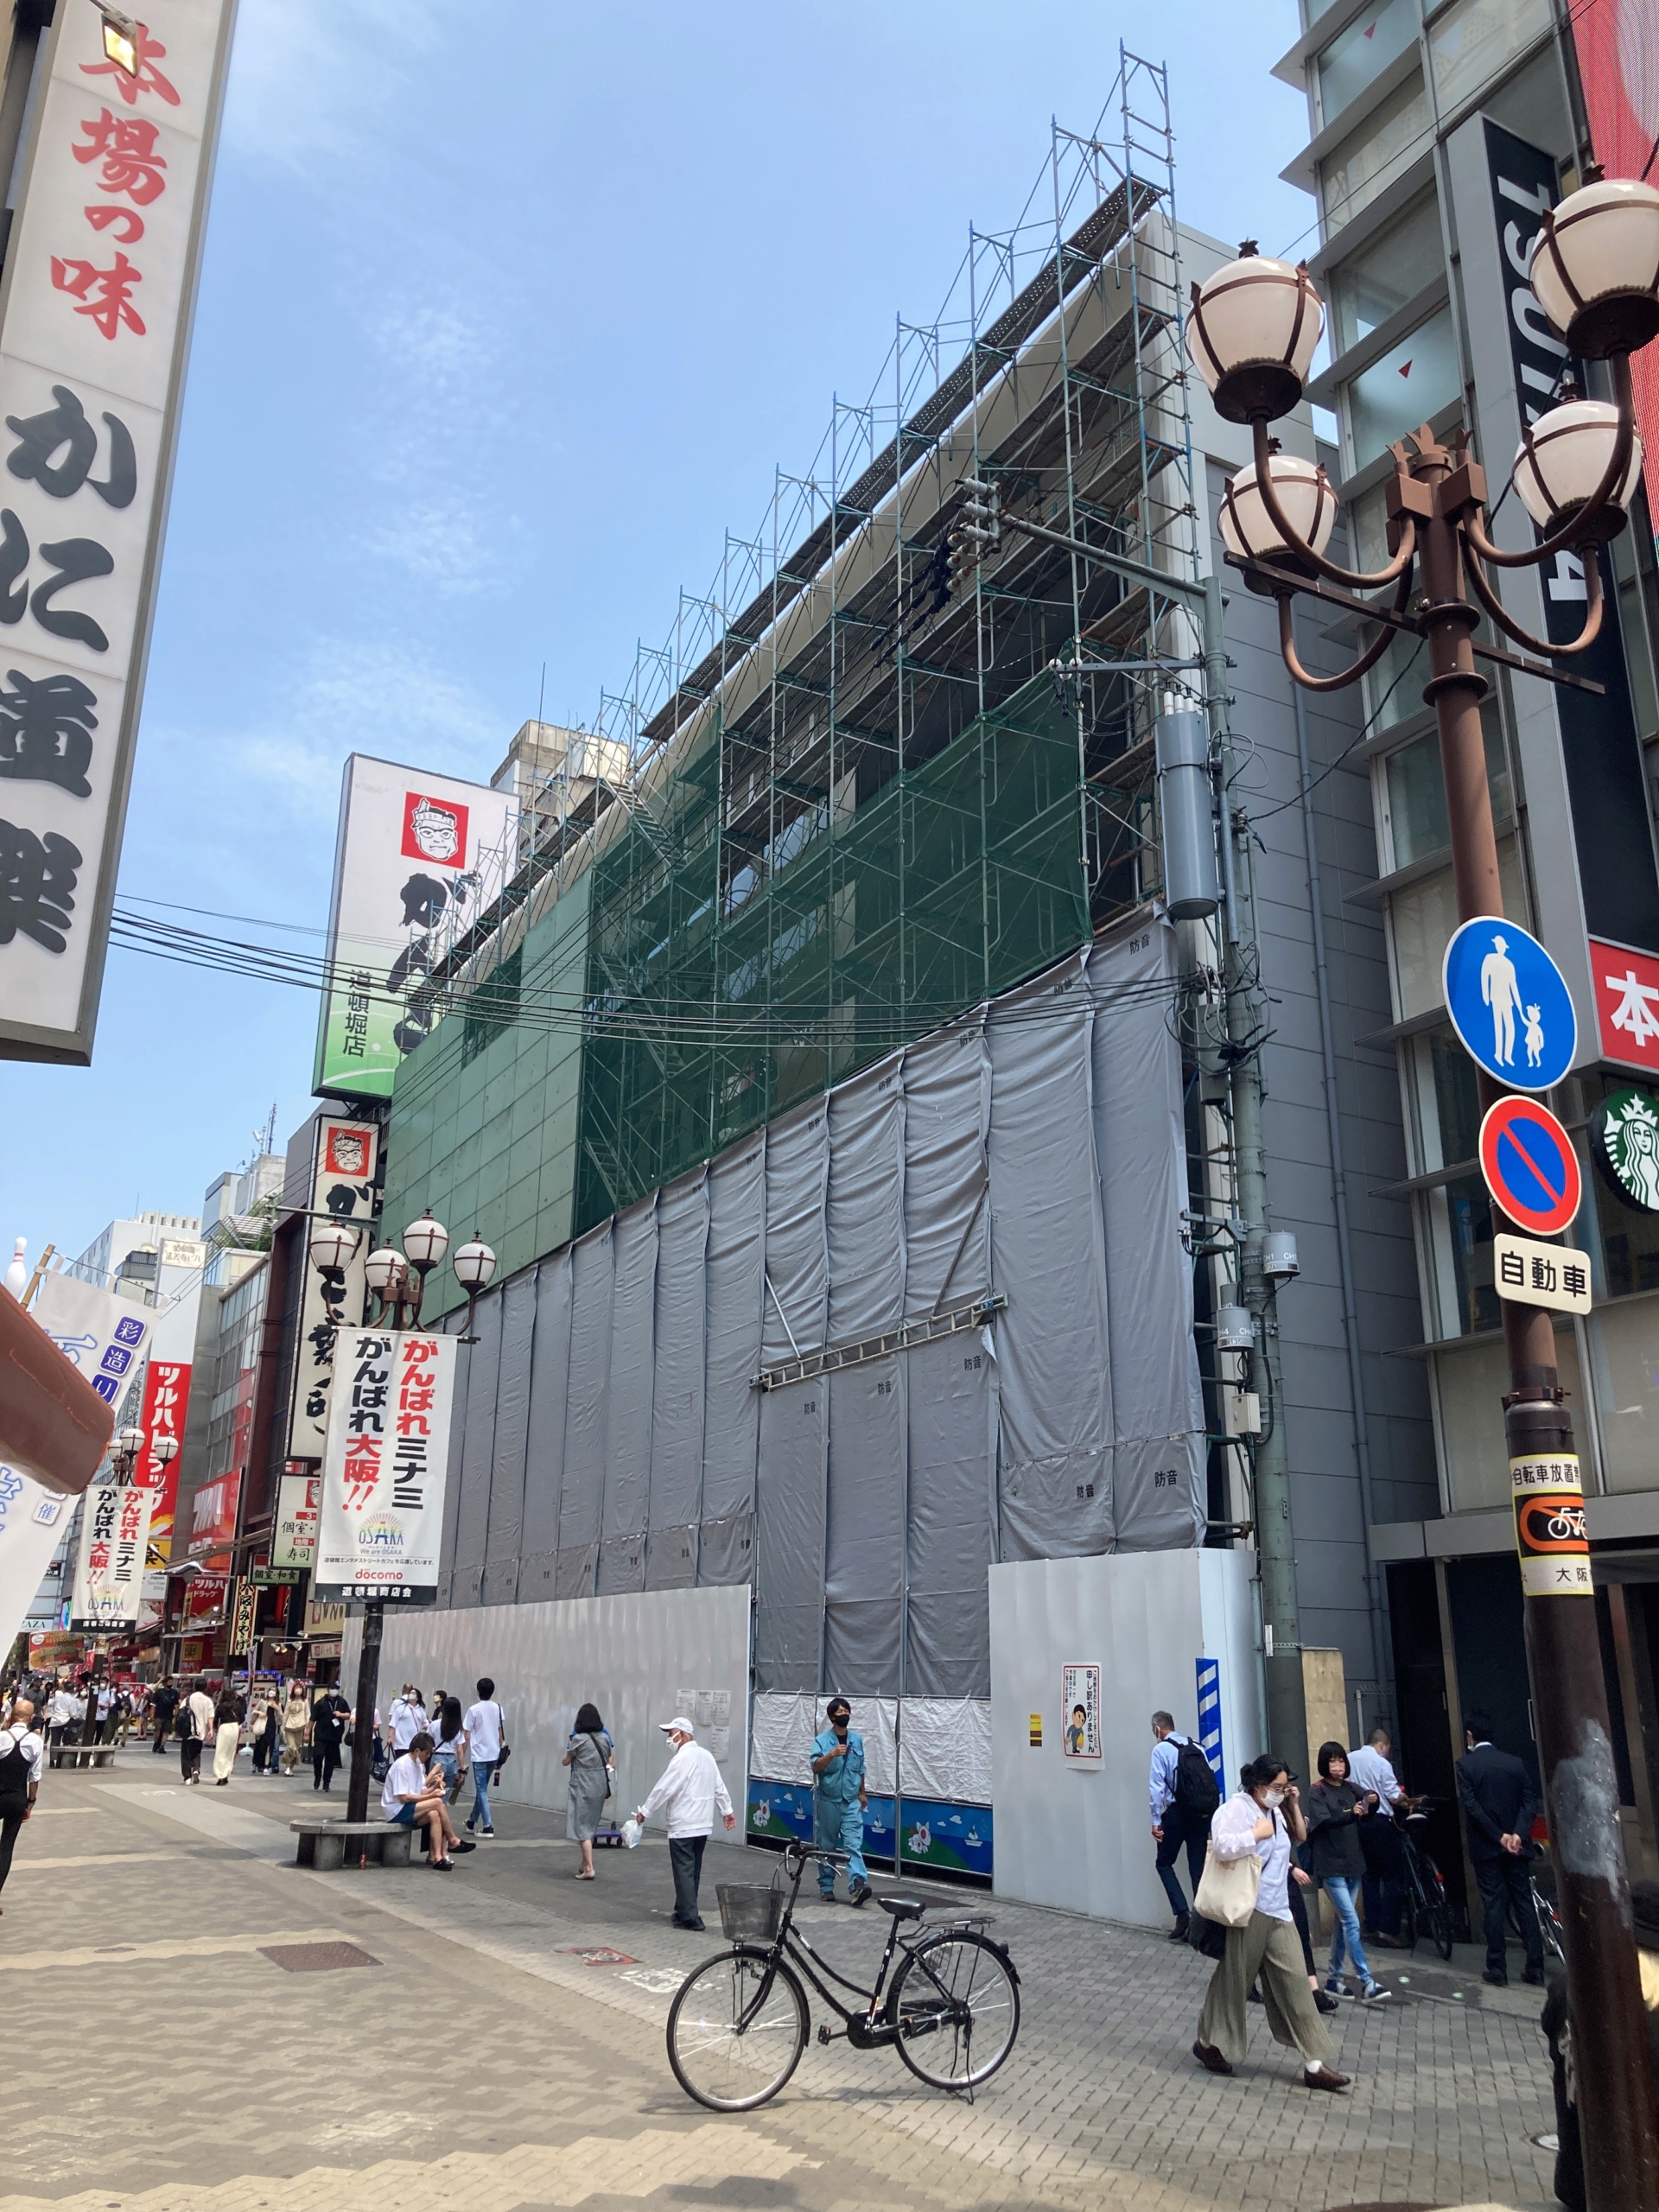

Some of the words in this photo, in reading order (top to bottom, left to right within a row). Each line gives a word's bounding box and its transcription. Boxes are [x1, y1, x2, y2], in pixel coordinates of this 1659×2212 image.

[51, 19, 181, 341] 本場の味
[1129, 933, 1150, 956] 防音
[343, 969, 372, 1058] 道頓堀店
[1605, 970, 1659, 1047] 本
[1501, 1250, 1587, 1298] 自動車
[96, 1321, 139, 1398] 彩造り
[963, 1355, 982, 1372] 防音
[877, 1380, 893, 1396] 防音
[391, 1339, 439, 1510] がんばれミナミ
[1076, 1484, 1095, 1499] 防音
[1154, 1469, 1178, 1489] 防音
[114, 1490, 144, 1582] がんばれミナミ
[194, 1580, 225, 1590] ツルハ
[355, 1568, 404, 1580] docomo
[1555, 1567, 1592, 1582] 大阪
[235, 1580, 254, 1651] 大阪みやげ
[1086, 1669, 1095, 1754] 申し訳ありません
